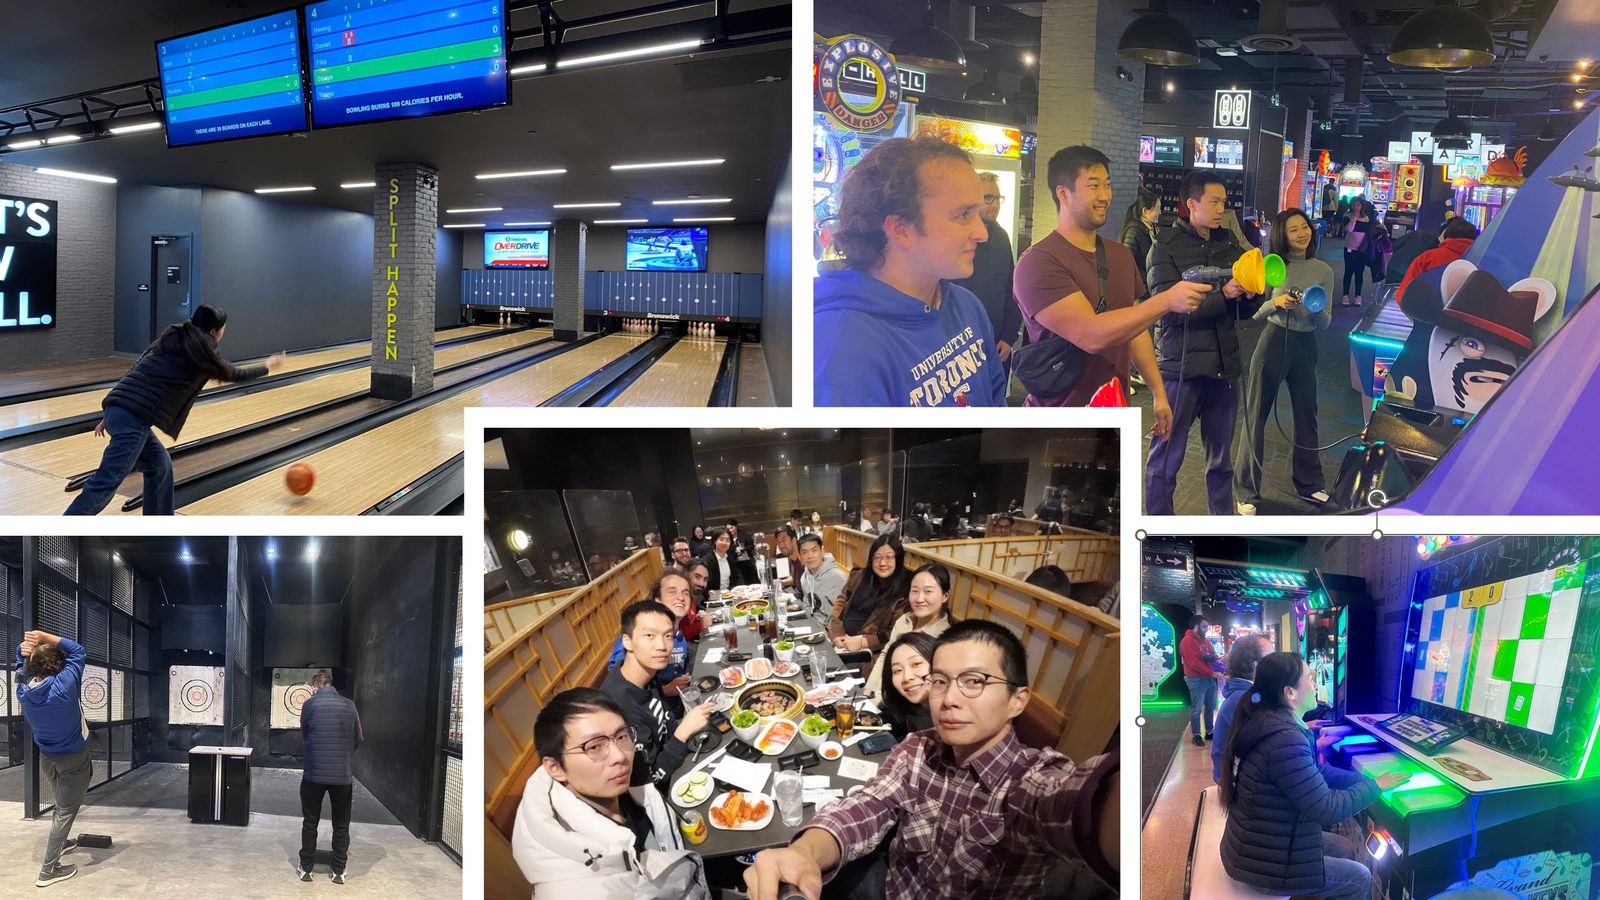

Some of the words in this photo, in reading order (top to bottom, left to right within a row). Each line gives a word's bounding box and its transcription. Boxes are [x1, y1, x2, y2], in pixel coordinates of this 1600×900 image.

[311, 8, 317, 18] 4
[492, 6, 498, 14] 8
[345, 20, 351, 28] 4
[492, 25, 498, 34] 0
[314, 41, 331, 49] Daniel
[346, 37, 352, 45] 8
[161, 46, 167, 54] 3
[290, 48, 296, 56] 7
[493, 44, 499, 53] 3
[347, 54, 353, 62] 0
[493, 63, 500, 71] 0
[822, 42, 898, 99] EXPLOSIVE
[295, 95, 300, 103] 0
[346, 104, 370, 114] BOWLING
[371, 102, 390, 112] BURNS
[401, 97, 430, 107] CALORIES
[431, 95, 444, 103] PER
[444, 92, 463, 101] HOUR.
[835, 104, 887, 128] DANGER
[222, 123, 239, 131] BOARDS
[388, 178, 399, 258] SPLIT
[494, 242, 540, 250] OVERDRIVE
[386, 265, 399, 360] HAPPEN
[646, 312, 680, 320] Brunswick
[911, 333, 966, 381] UNIVERSITY
[1468, 590, 1474, 602] 2
[1488, 586, 1495, 598] 0
